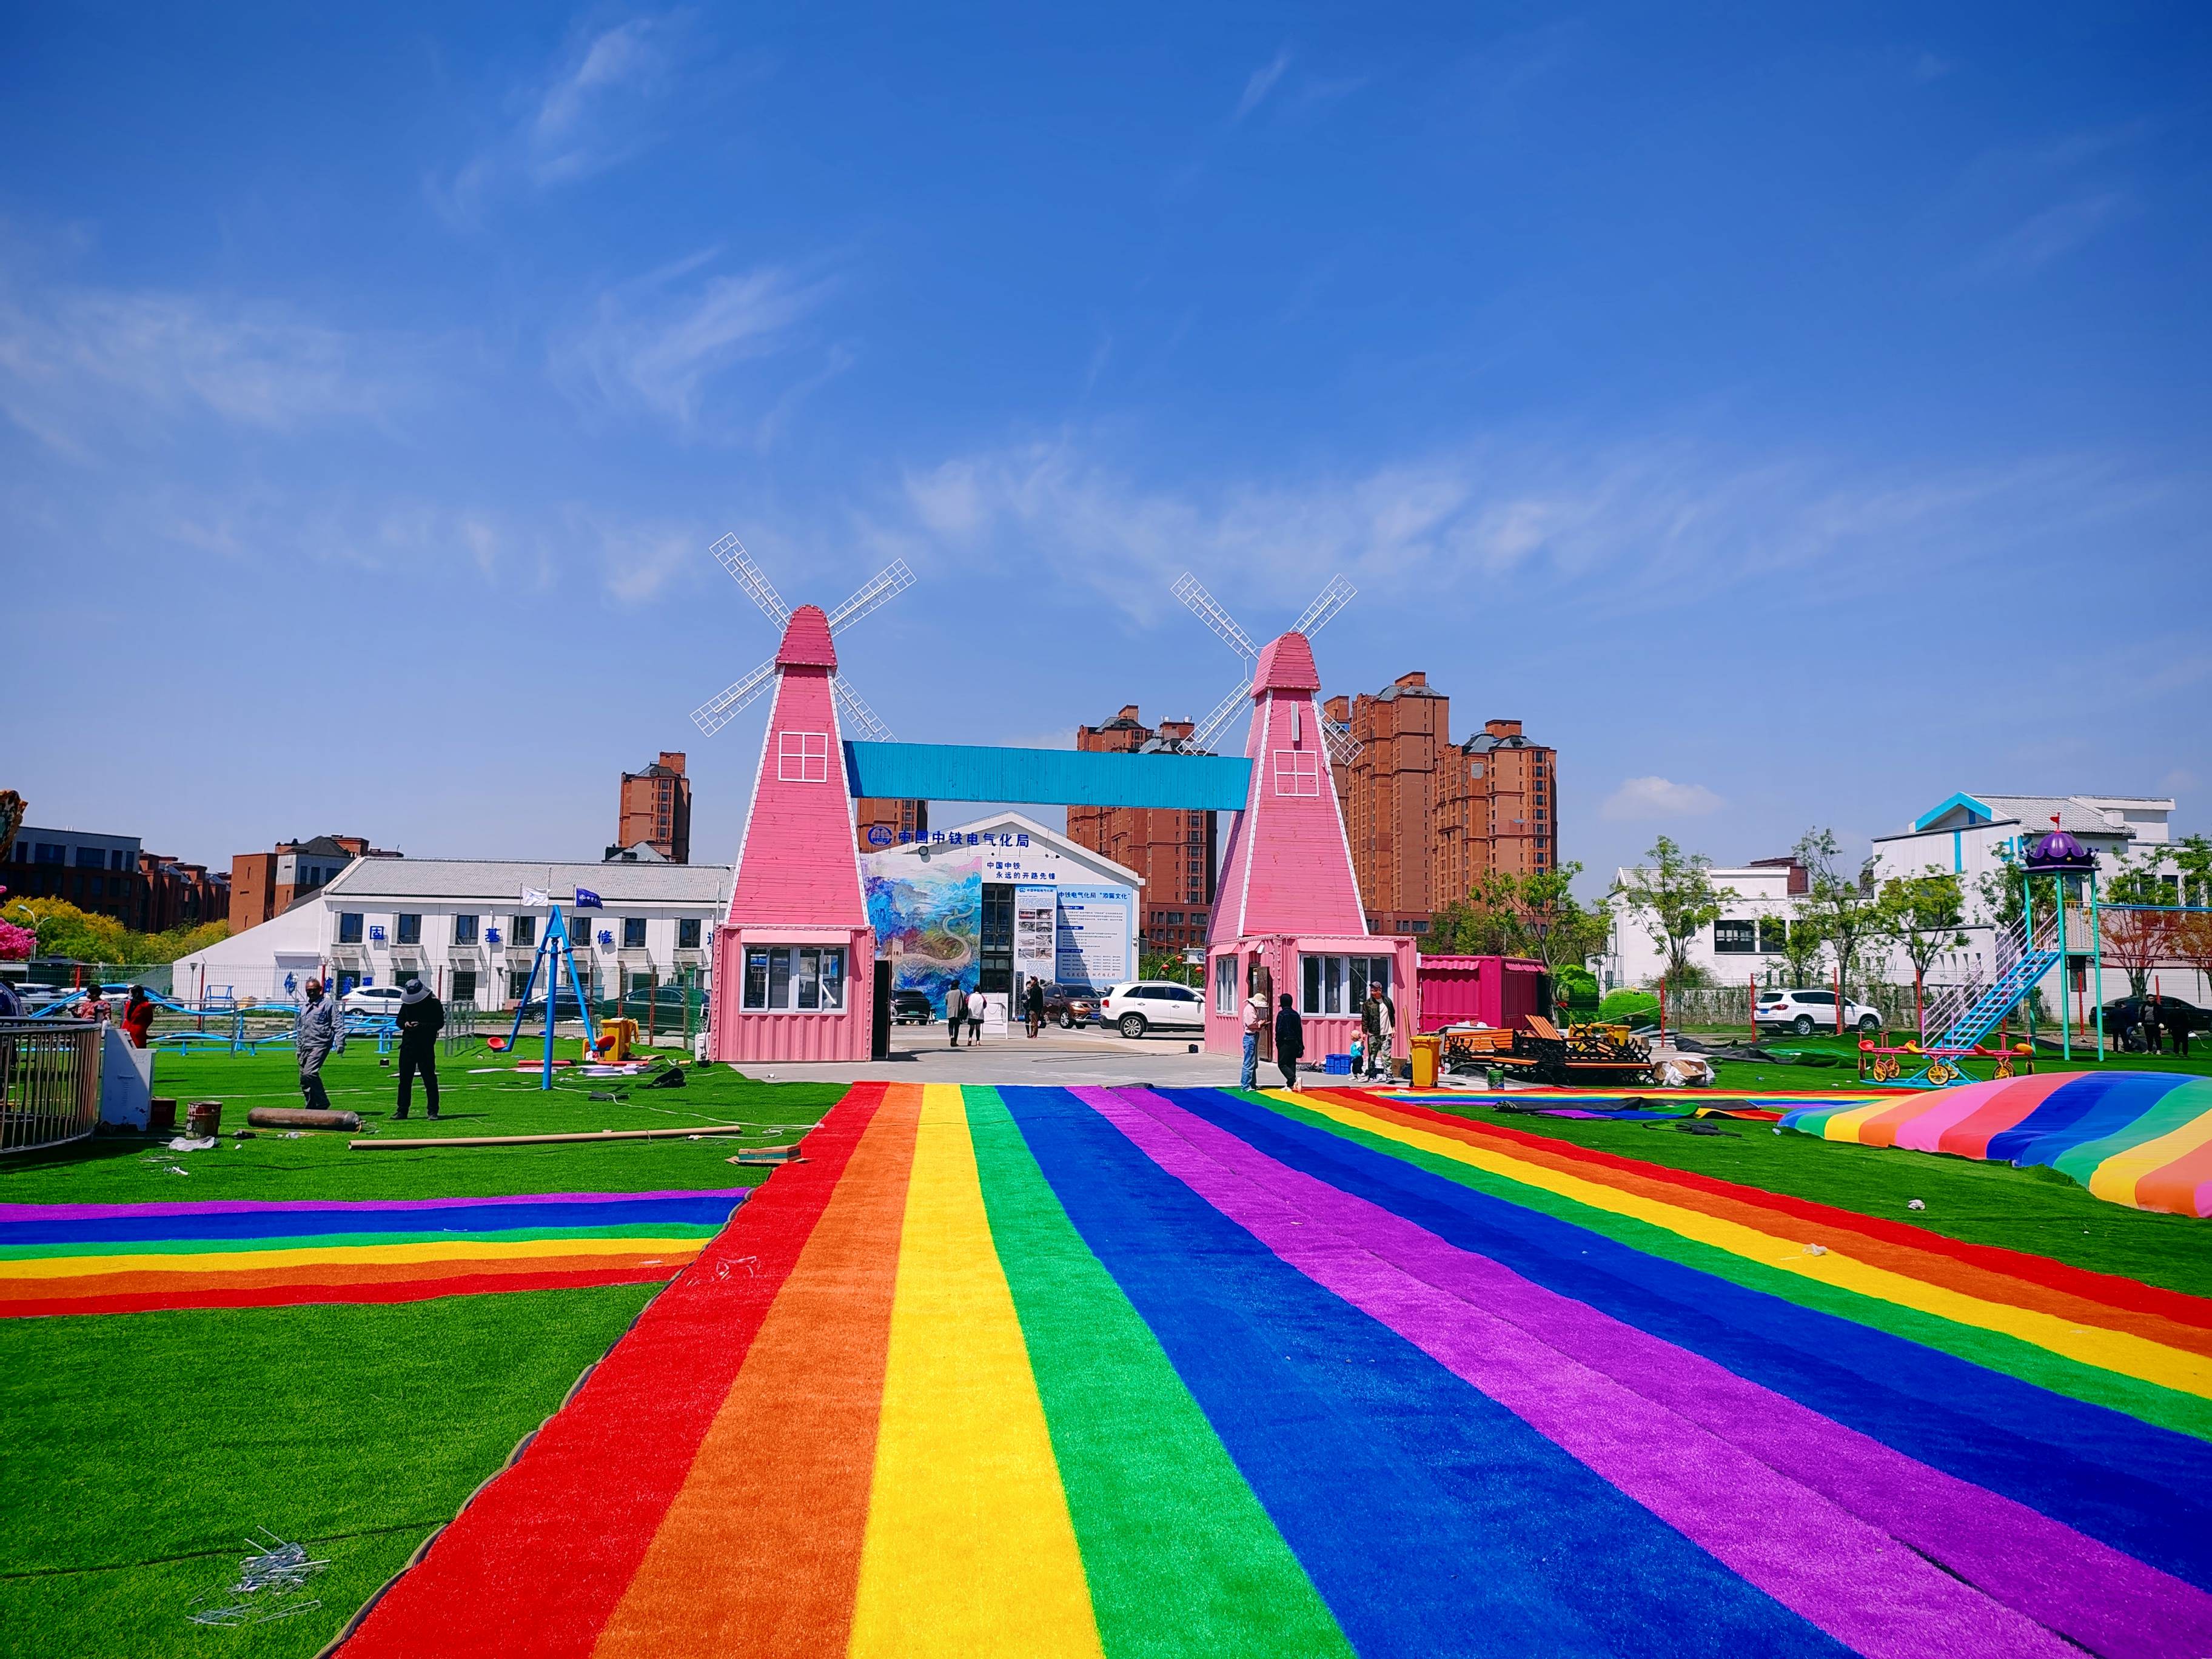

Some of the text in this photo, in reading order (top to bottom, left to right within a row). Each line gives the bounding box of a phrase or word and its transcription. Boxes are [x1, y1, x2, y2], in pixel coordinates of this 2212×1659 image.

[898, 830, 1030, 848] 中国中铁电气化局
[987, 861, 1021, 870] 中国中铁
[996, 871, 1056, 880] 永远的开路先锋
[370, 926, 612, 944] 固 基 修
